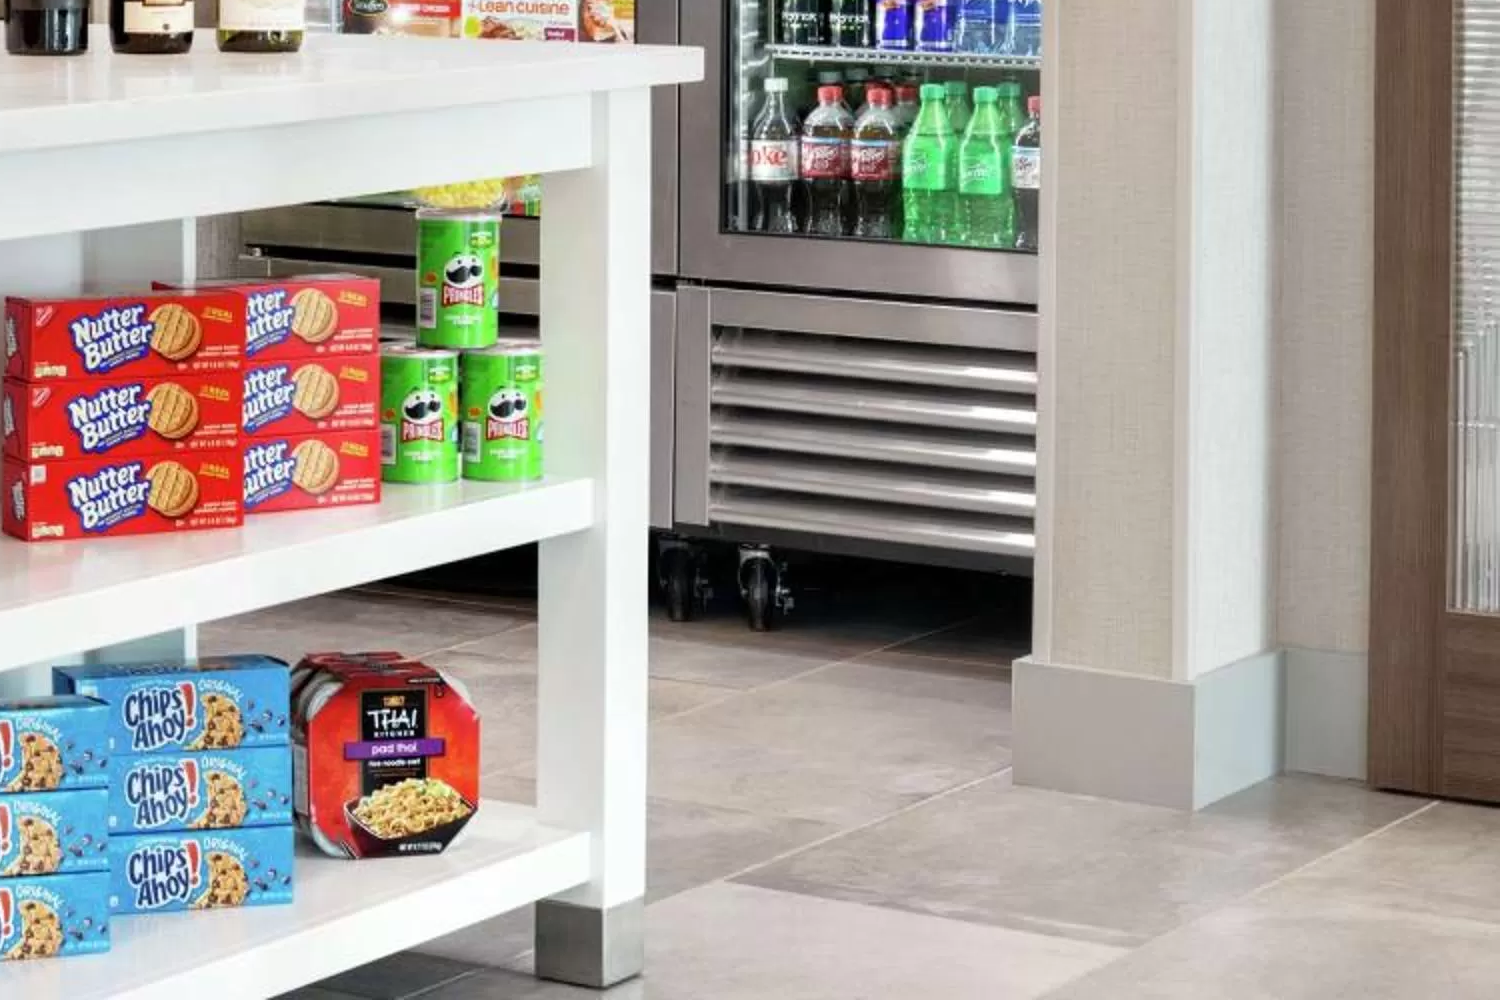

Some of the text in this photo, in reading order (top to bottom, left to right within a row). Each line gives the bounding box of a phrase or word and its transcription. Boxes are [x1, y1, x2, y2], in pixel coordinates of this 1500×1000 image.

[752, 147, 788, 167] oke
[247, 290, 285, 318] tter
[73, 305, 145, 346] Nutter
[246, 307, 293, 342] utter
[82, 321, 153, 371] Butter
[70, 384, 142, 424] Nutter
[243, 383, 294, 422] utter
[82, 400, 150, 450] Butter
[68, 462, 142, 503] Nutter
[243, 458, 294, 499] utter
[82, 479, 150, 528] Butter
[124, 687, 183, 728] Chips
[367, 709, 418, 731] THAI
[371, 743, 395, 756] pad
[126, 766, 185, 806] Chips
[127, 847, 187, 886] Chips
